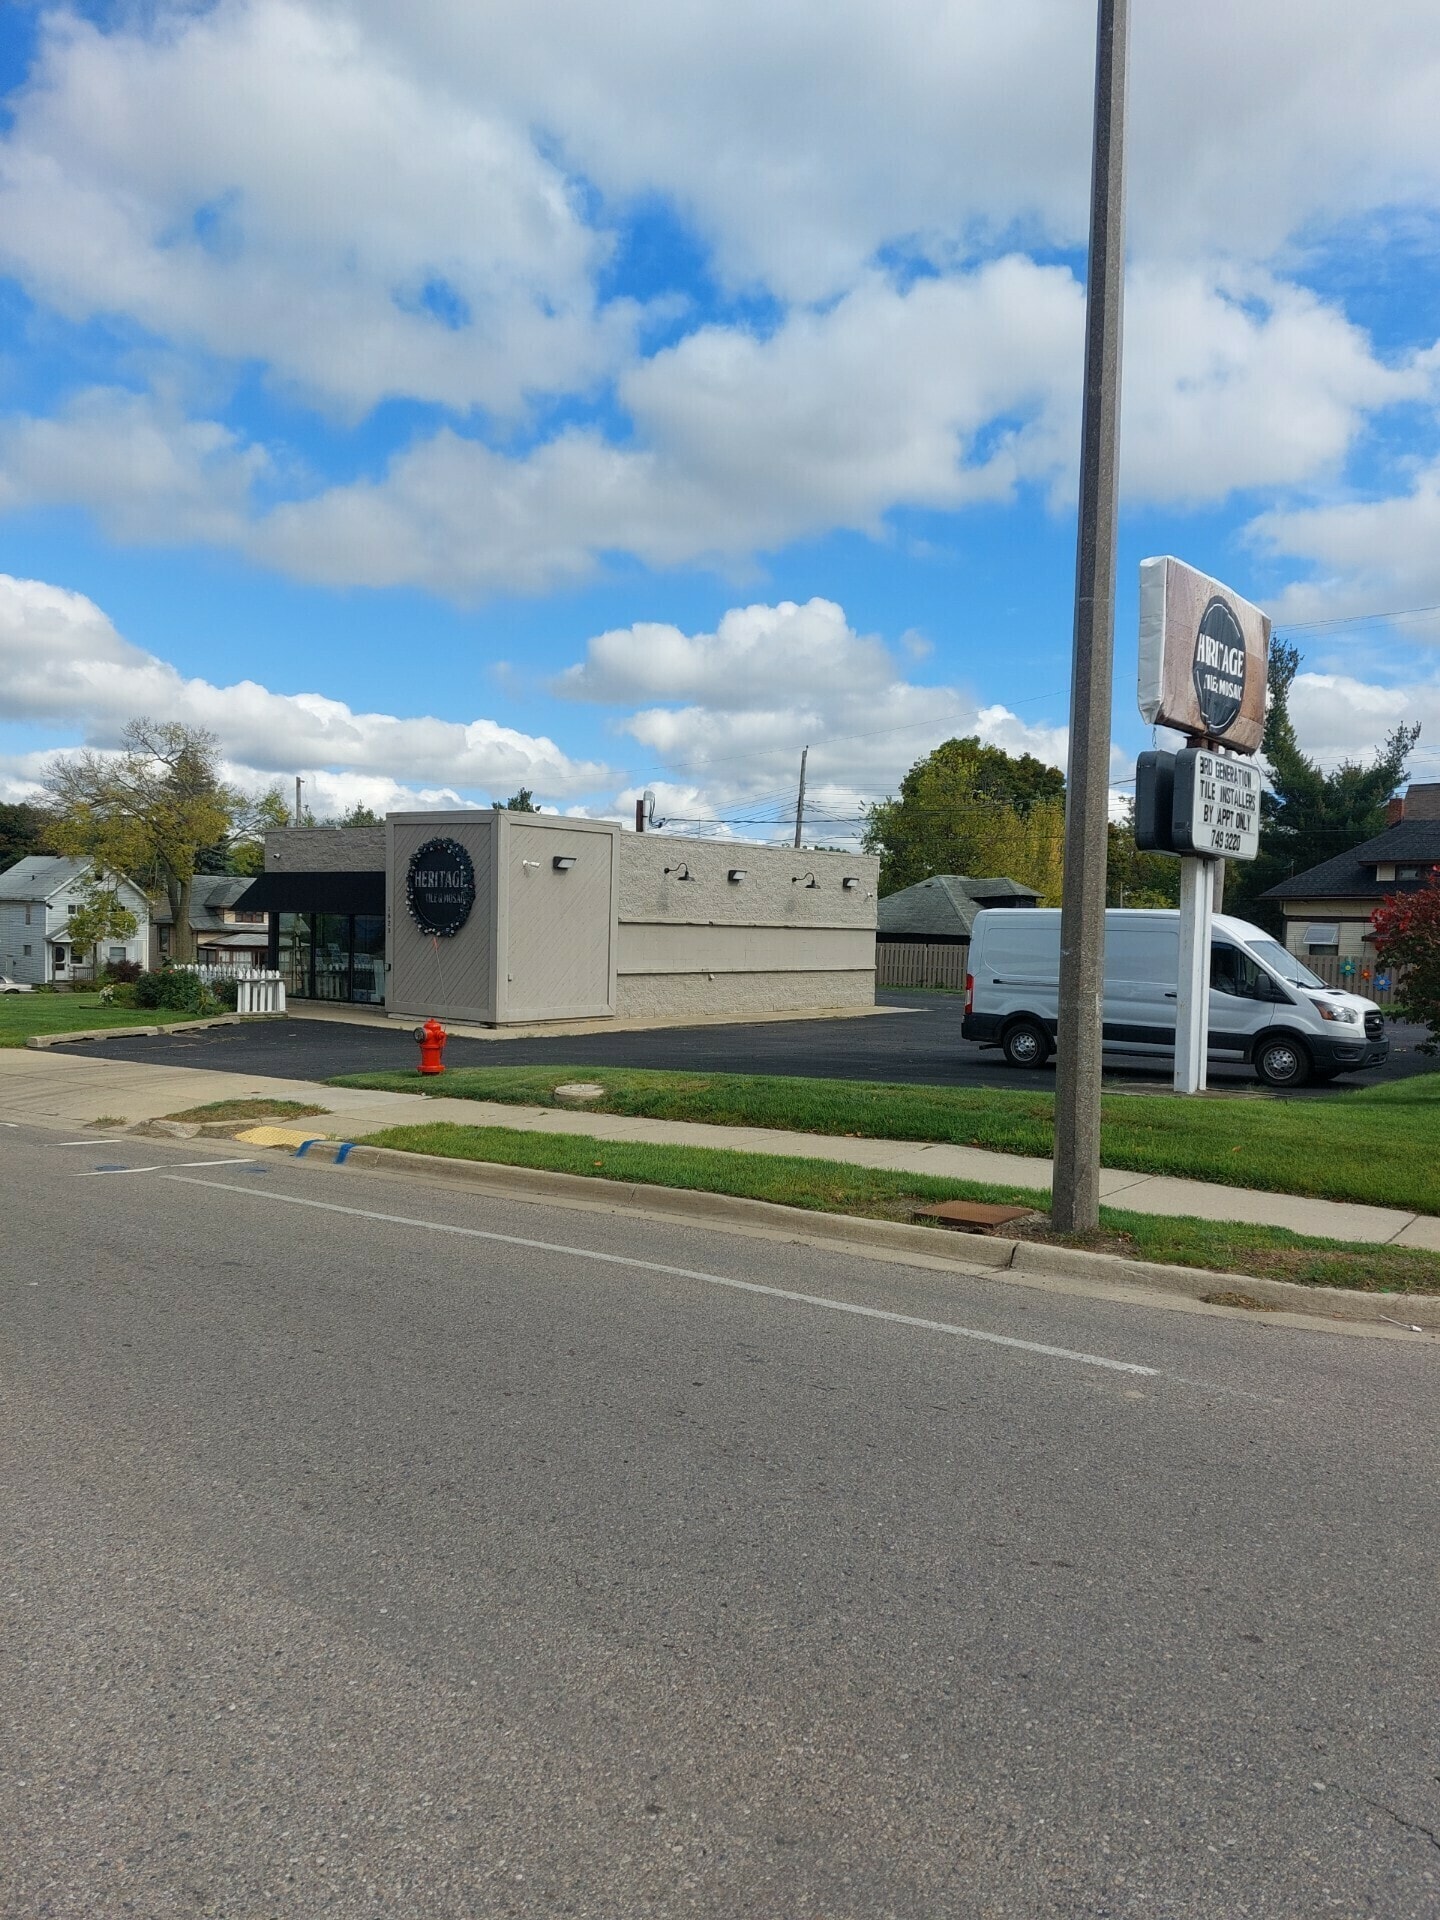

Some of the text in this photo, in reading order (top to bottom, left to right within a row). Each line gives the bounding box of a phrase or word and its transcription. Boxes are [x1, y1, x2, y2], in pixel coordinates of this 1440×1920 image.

[1200, 756, 1251, 789] 3RD GENERATION
[1200, 779, 1256, 811] TILE INSTALLERS
[1203, 804, 1251, 831] BY APPT ONLY
[1211, 829, 1224, 848] 749
